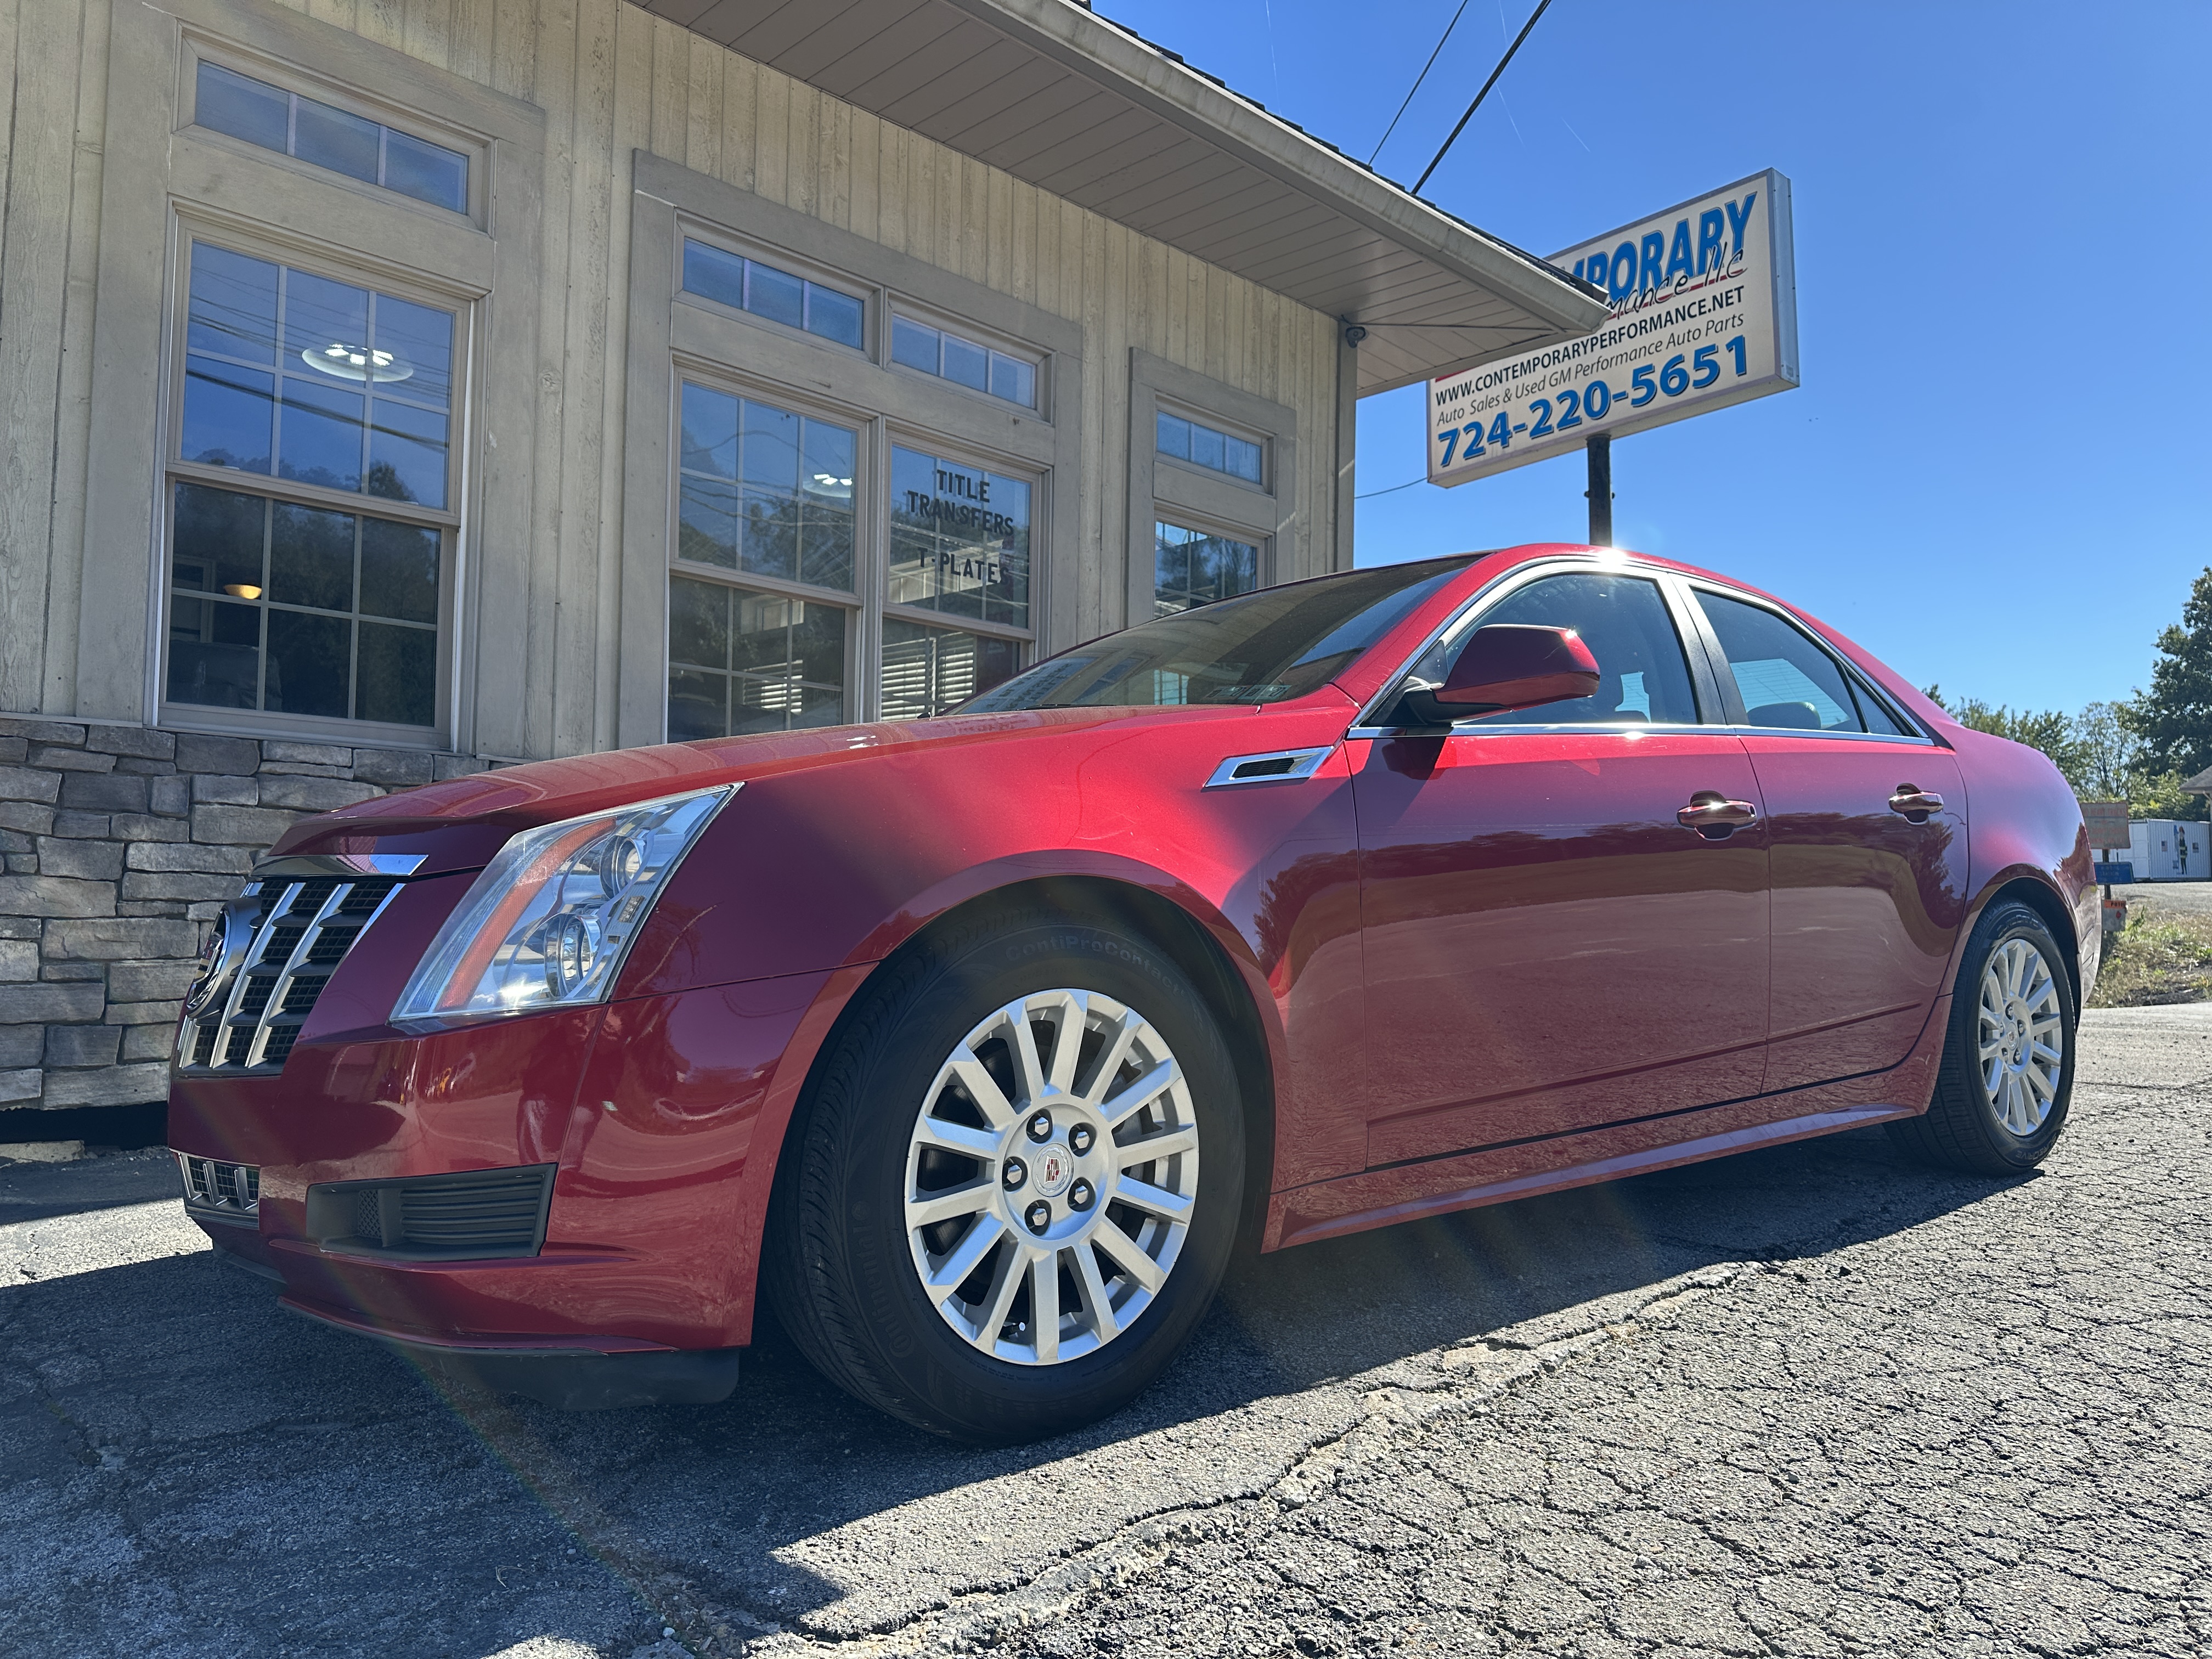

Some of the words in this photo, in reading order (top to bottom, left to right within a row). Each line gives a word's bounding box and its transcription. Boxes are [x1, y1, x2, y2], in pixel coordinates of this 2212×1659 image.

[1435, 285, 1745, 407] WWW.CONTEMPORARYPERFORMANCE.NET
[1436, 407, 1465, 427] Auto
[1469, 394, 1500, 415] Sales
[1503, 388, 1513, 404] &
[1515, 375, 1547, 399] Used
[1549, 366, 1572, 387] GM
[1574, 340, 1663, 380] Performance
[1666, 328, 1702, 350] Auto
[1705, 313, 1745, 337] Parts
[1437, 335, 1747, 468] 724-220-5651
[907, 490, 1014, 536] TRANSFERS
[936, 469, 990, 503] TITLE
[1005, 935, 1182, 996] ContiProContact
